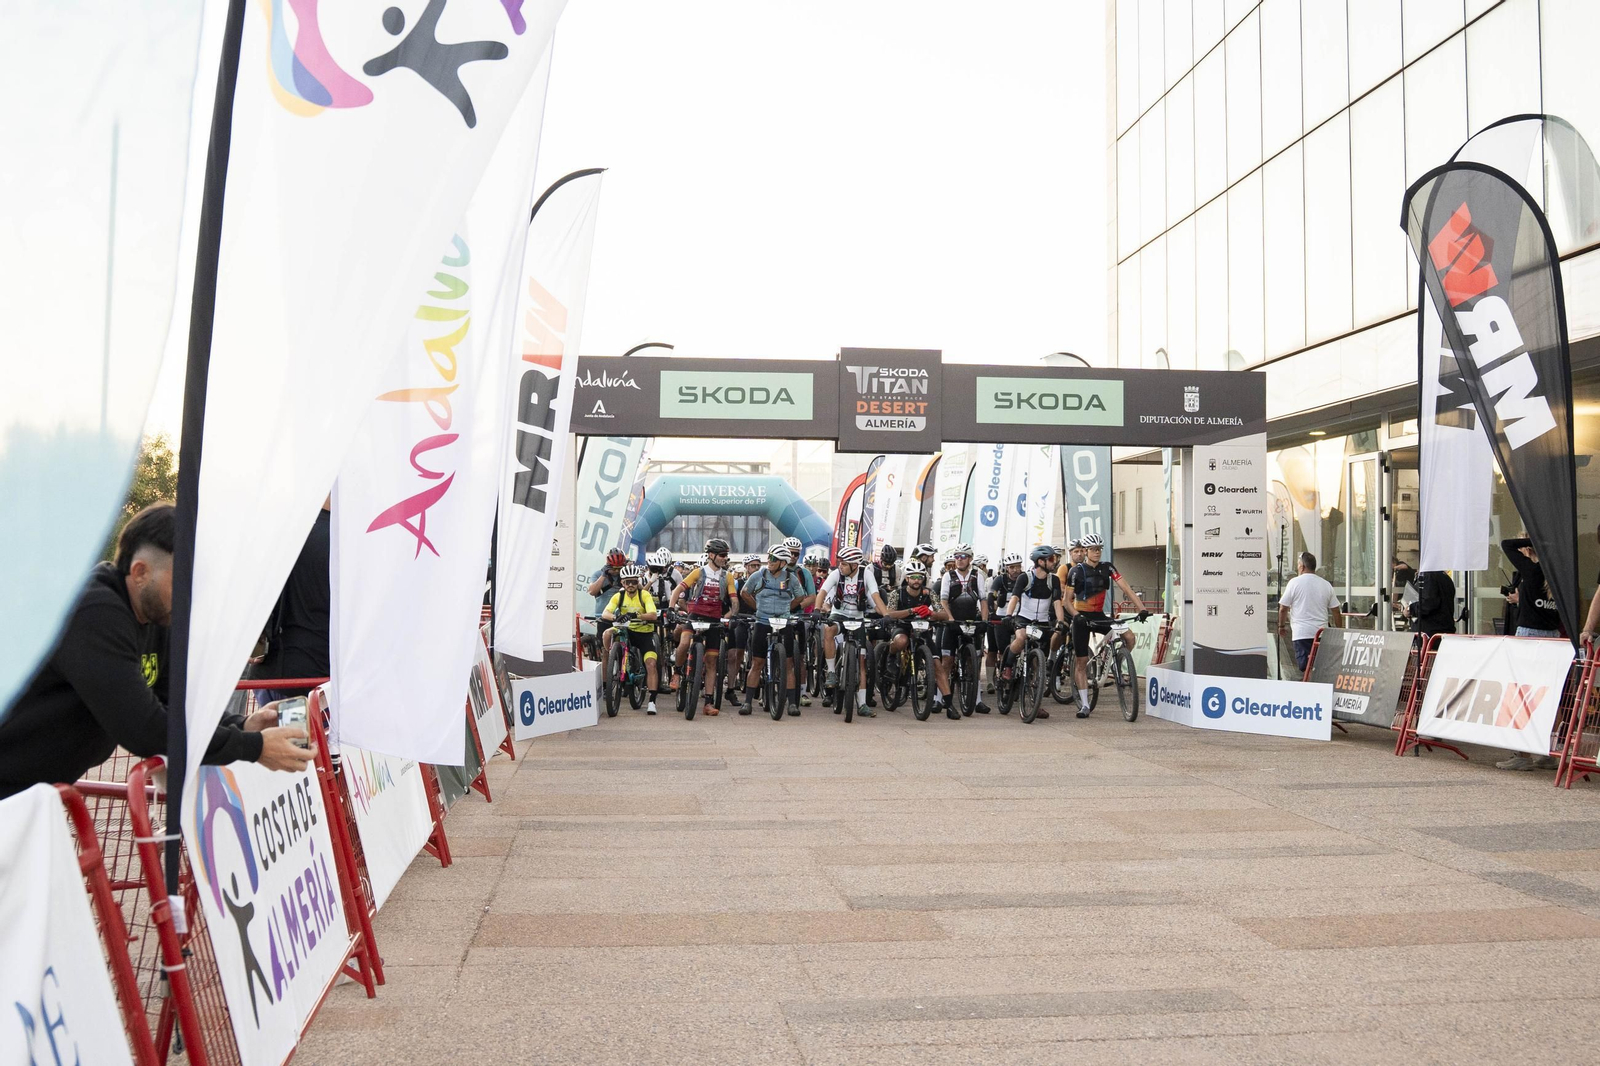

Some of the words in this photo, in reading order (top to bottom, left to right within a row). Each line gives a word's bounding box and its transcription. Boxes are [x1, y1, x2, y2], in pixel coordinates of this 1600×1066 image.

[574, 368, 641, 390] ndalucía
[845, 365, 928, 394] TITAN
[366, 233, 470, 561] Andaluc
[513, 276, 568, 514] MRW
[856, 401, 928, 414] DESERT
[865, 418, 916, 429] ALMERÍA
[1139, 415, 1192, 424] DIPUTACIÓN
[1194, 416, 1205, 424] DE
[1206, 416, 1243, 425] ALMERÍA
[987, 443, 1004, 501] Clearde
[580, 437, 632, 554] SKO
[679, 484, 767, 497] UNIVERSAE
[711, 497, 743, 505] Superior
[1218, 486, 1257, 494] Cleardent
[1342, 632, 1382, 667] TITAN
[1335, 674, 1376, 692] DESERT
[538, 690, 592, 716] Cleardent
[1160, 687, 1191, 709] Cleardent
[1231, 697, 1322, 721] Cleardent
[1335, 696, 1362, 711] ALMERÍA
[1434, 677, 1550, 730] MRW
[253, 788, 301, 872] COSTA
[296, 776, 317, 832] DE
[267, 836, 339, 1002] ALMERÍA
